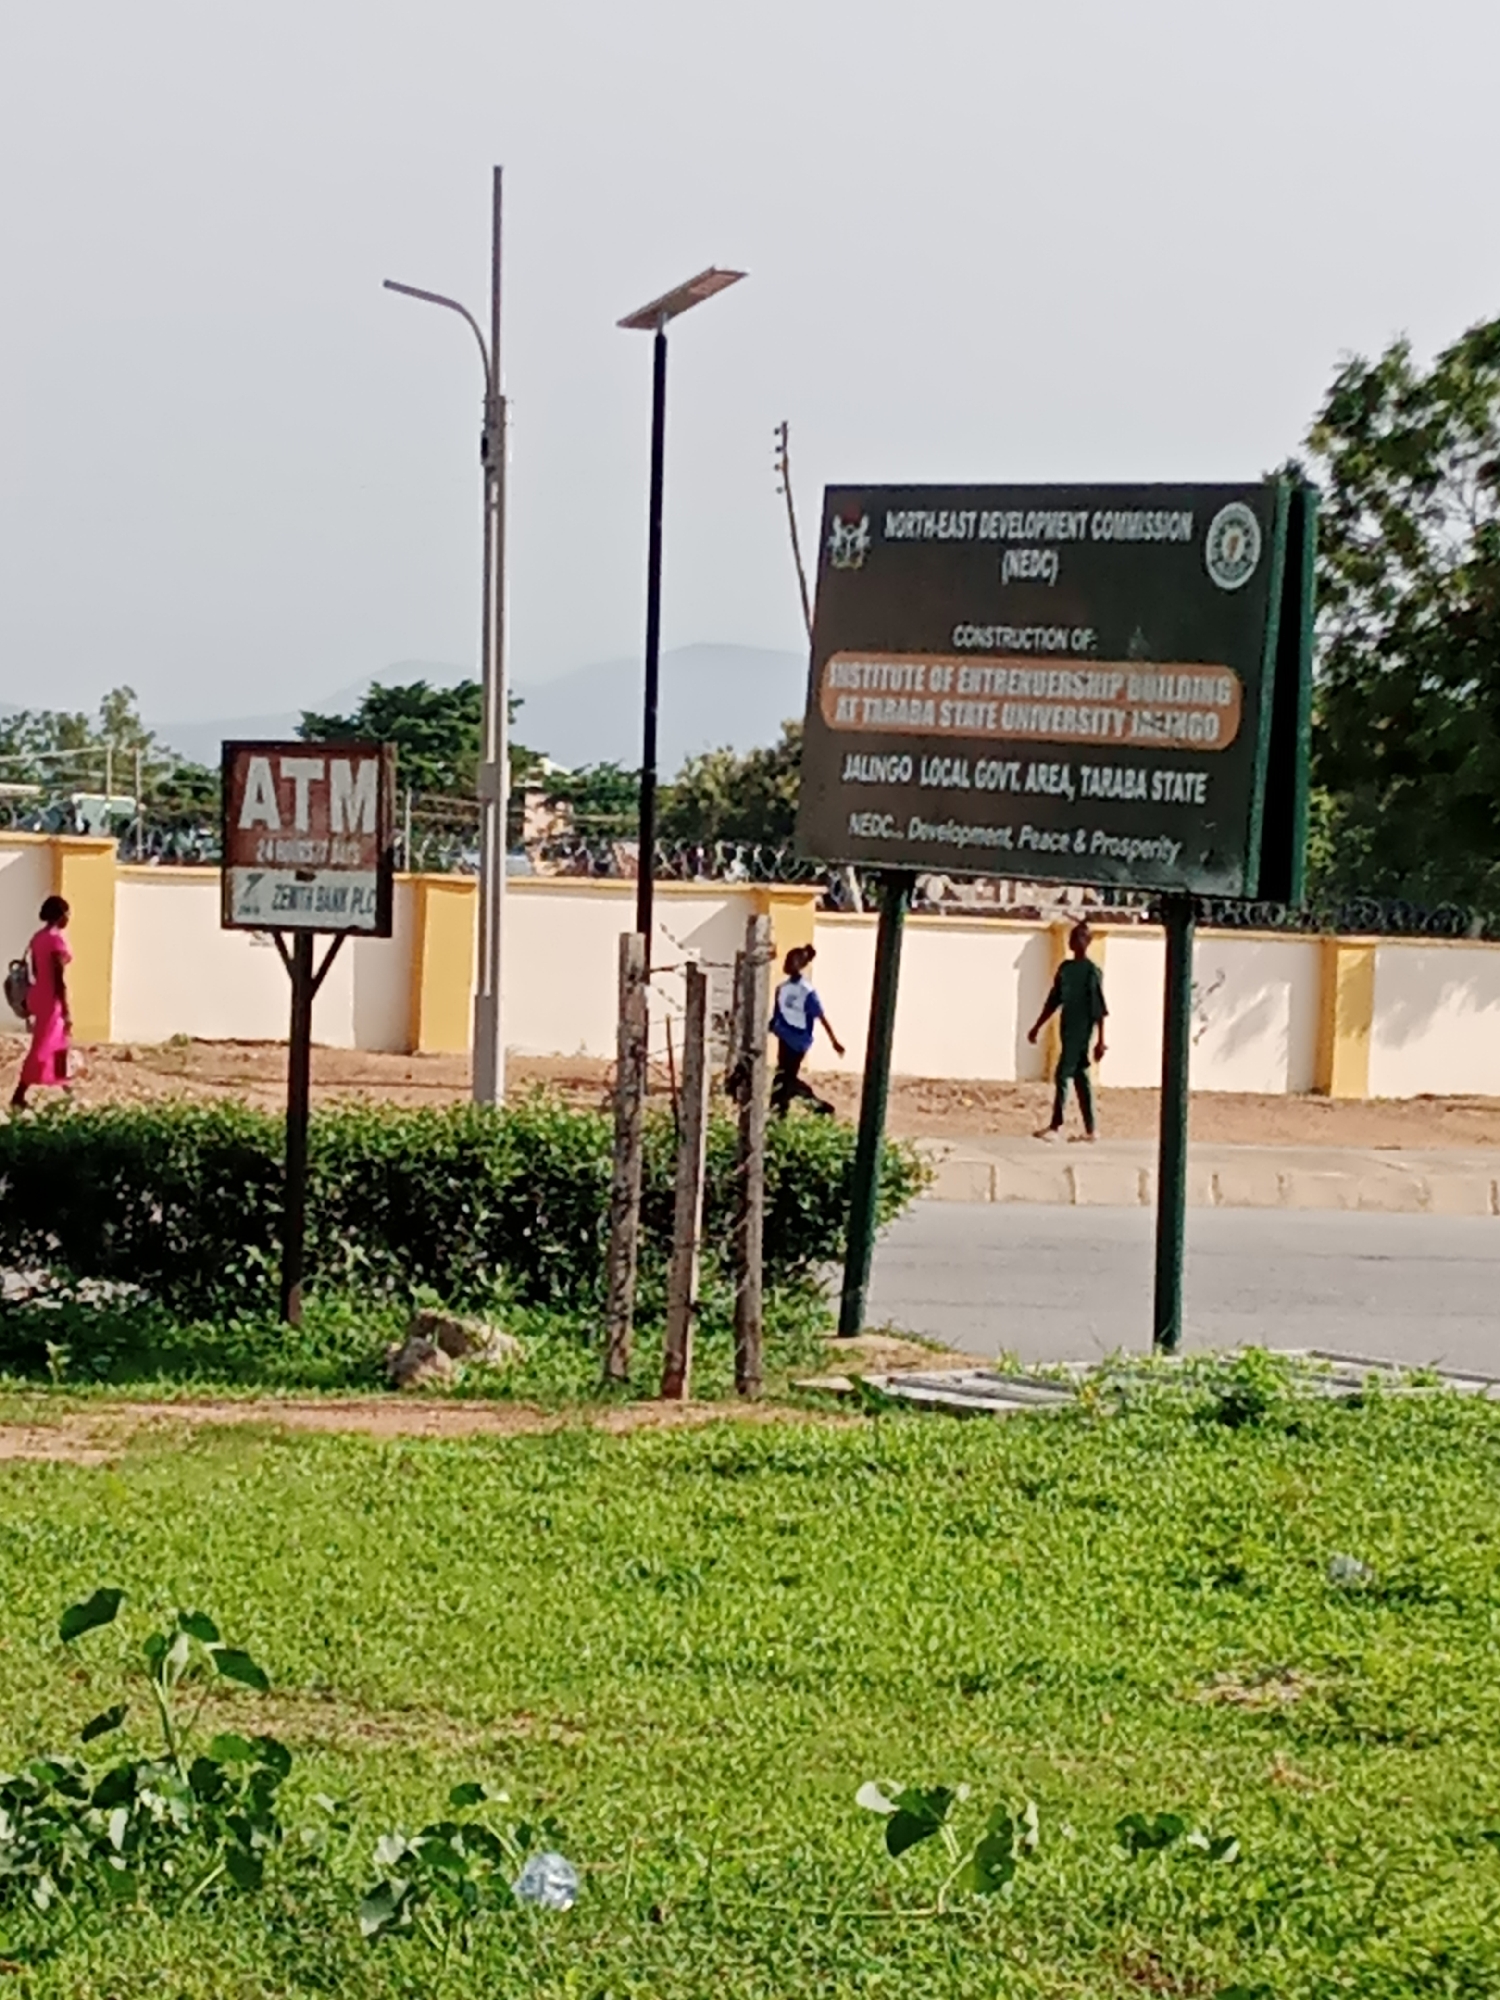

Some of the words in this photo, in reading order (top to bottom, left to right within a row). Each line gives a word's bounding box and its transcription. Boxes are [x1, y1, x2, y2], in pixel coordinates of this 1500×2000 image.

[884, 510, 978, 540] NORTH-EAST
[978, 510, 1089, 540] DEVELOPMENT
[1091, 510, 1194, 542] COMMISSION
[1001, 549, 1059, 587] (NEDC)
[953, 625, 1069, 651] CONSTRUCTION
[829, 661, 926, 692] INSTITUTE
[929, 665, 956, 693] OF
[1126, 672, 1232, 706] BUILDING
[834, 696, 856, 723] AT
[862, 697, 936, 726] TARABA
[939, 701, 998, 730] STATE
[1001, 702, 1127, 737] UNIVERSITY
[237, 756, 379, 836] ATM
[842, 754, 914, 783] JALINGO
[920, 756, 971, 789] LOCAL
[974, 758, 1022, 792] GOVT.
[1024, 761, 1075, 802] AREA,
[1080, 764, 1148, 800] TARABA
[1151, 769, 1210, 804] STATE
[907, 815, 1014, 850] Development,
[1016, 824, 1071, 852] Peace
[1072, 828, 1087, 854] &
[1089, 829, 1184, 866] Prosperity
[271, 884, 315, 911] ZENITH
[314, 885, 350, 913] BANK
[350, 886, 377, 915] PLC
